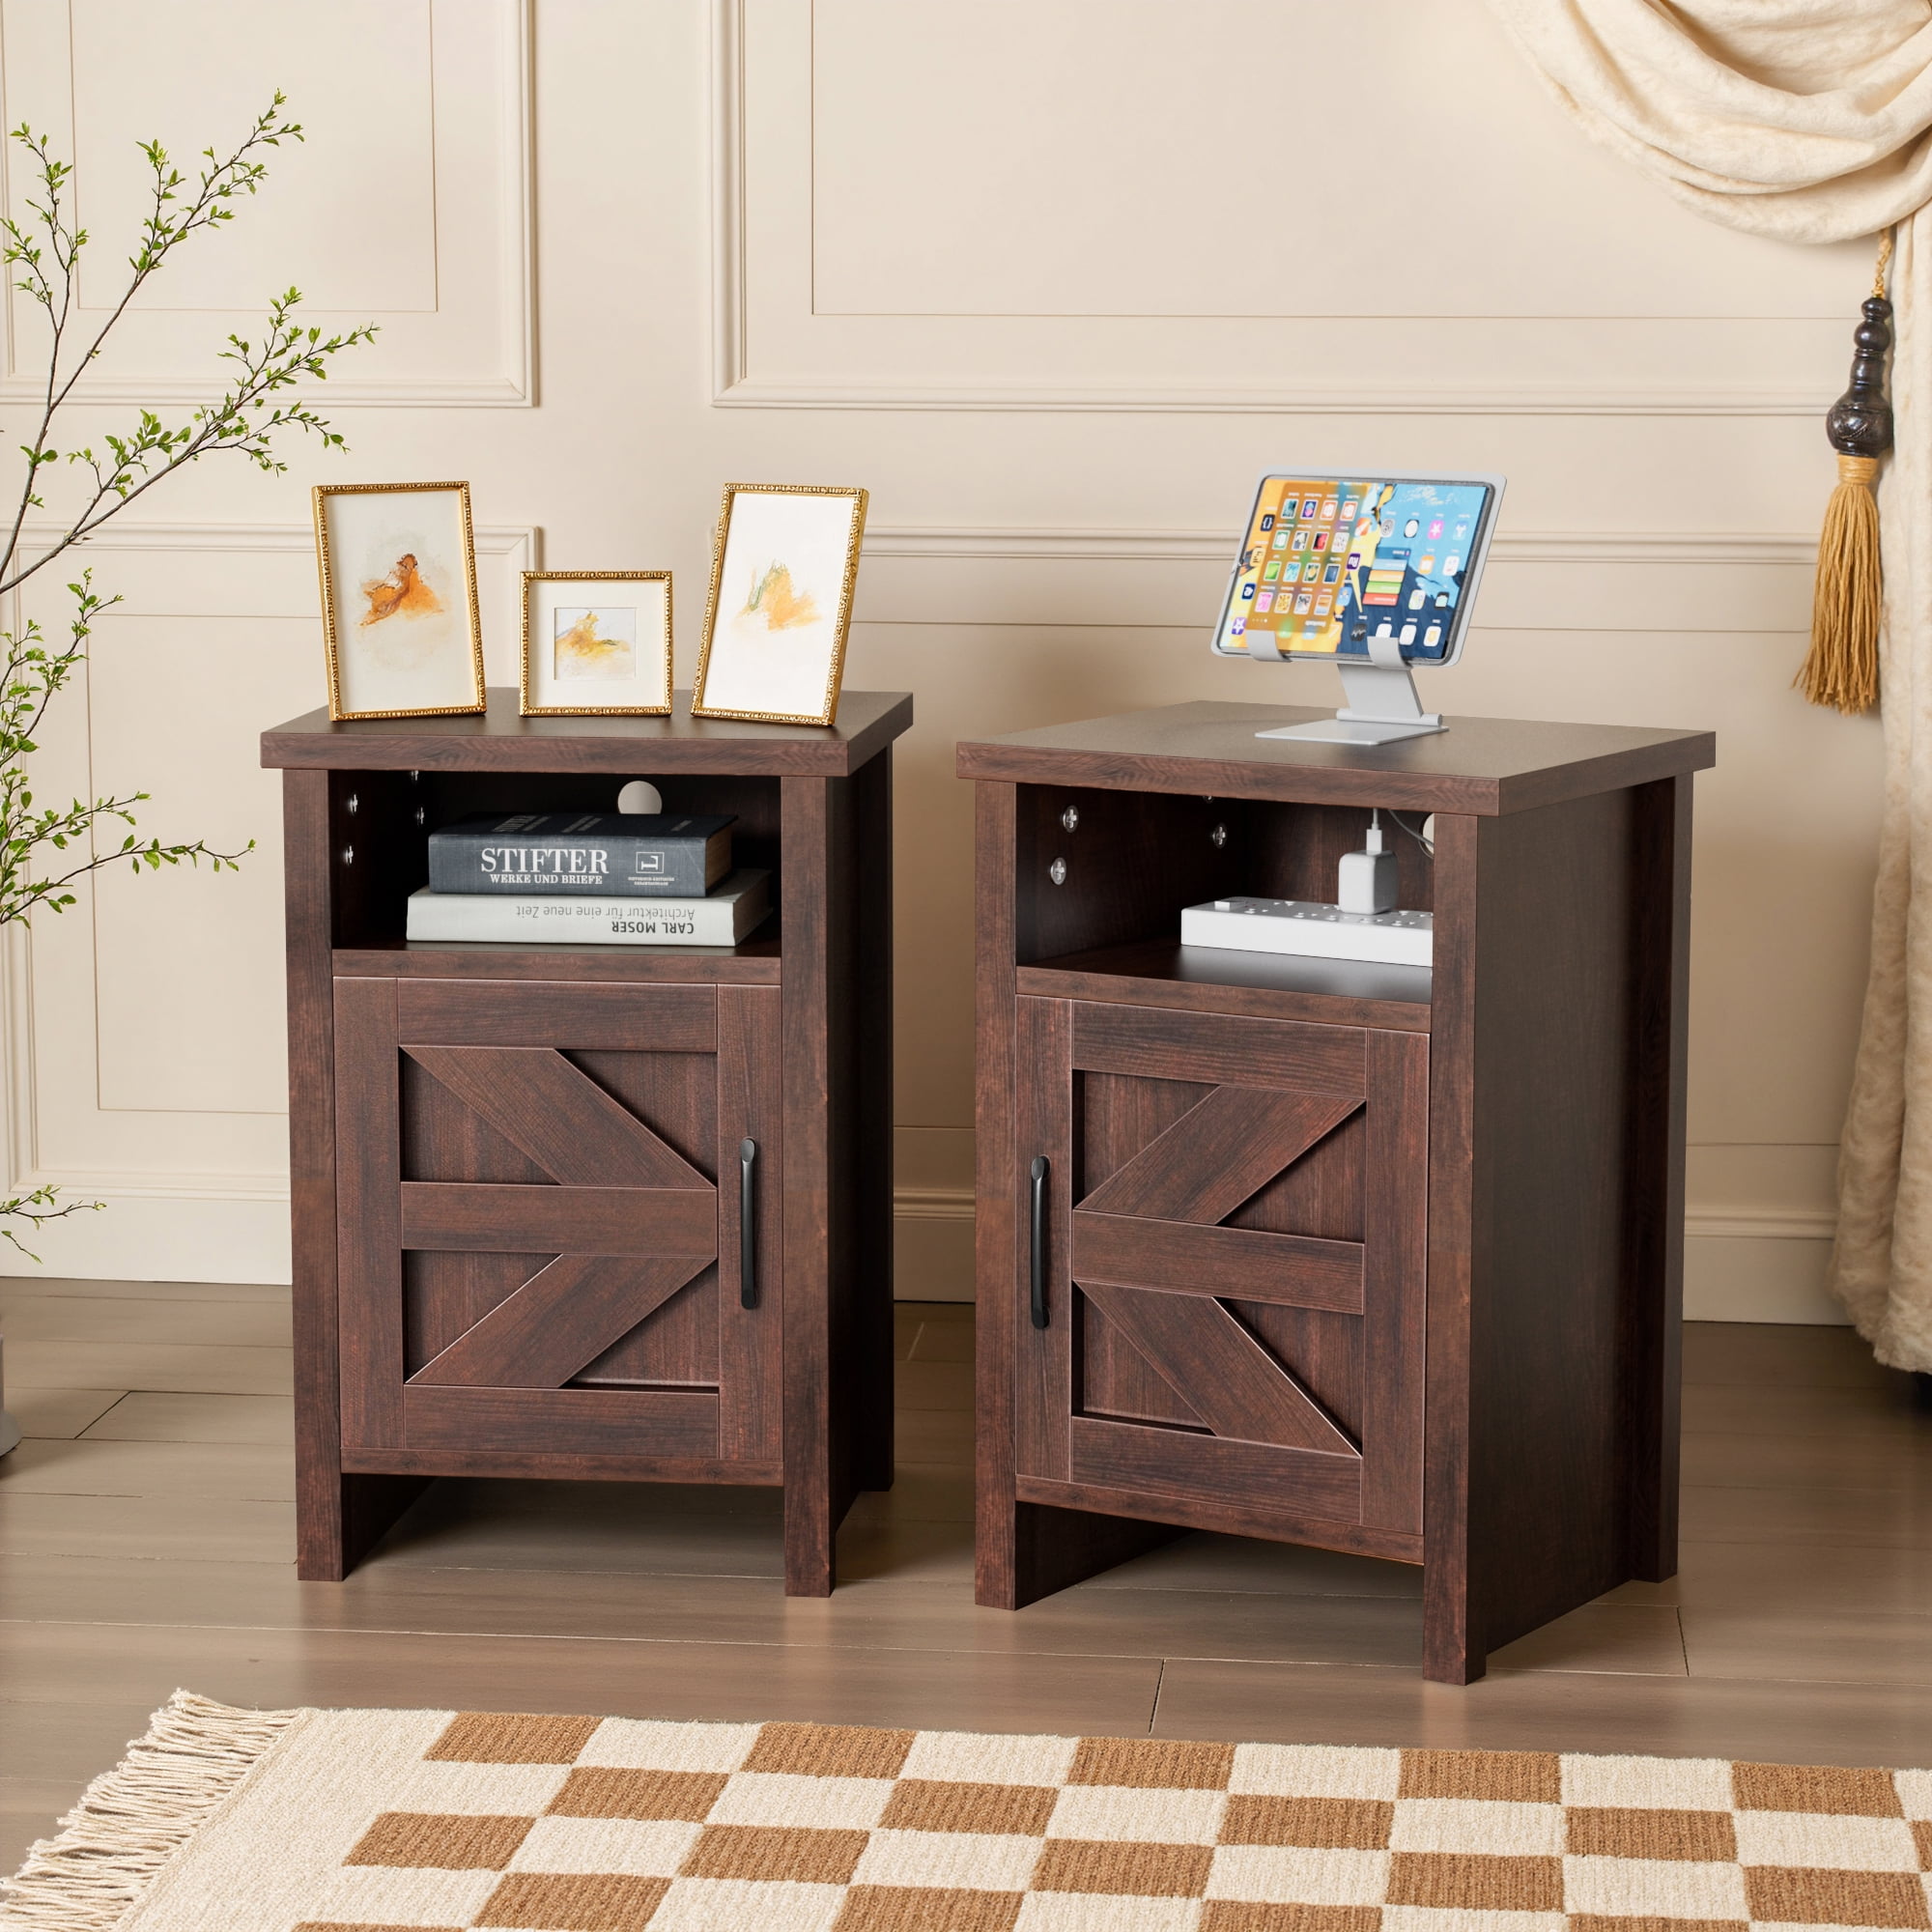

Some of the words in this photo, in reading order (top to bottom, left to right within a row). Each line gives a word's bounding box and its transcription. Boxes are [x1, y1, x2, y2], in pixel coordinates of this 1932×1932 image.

[481, 848, 610, 874] STIFTER
[640, 855, 659, 870] L
[490, 874, 531, 884] WERKE
[534, 874, 558, 884] UND
[561, 875, 603, 885] BRIEFE
[516, 905, 540, 918] Zeit
[543, 906, 572, 917] neue
[577, 906, 602, 918] eine
[606, 907, 623, 921] für
[627, 907, 696, 921] Architektur
[611, 921, 656, 933] MOSER
[662, 922, 695, 934] CARL
